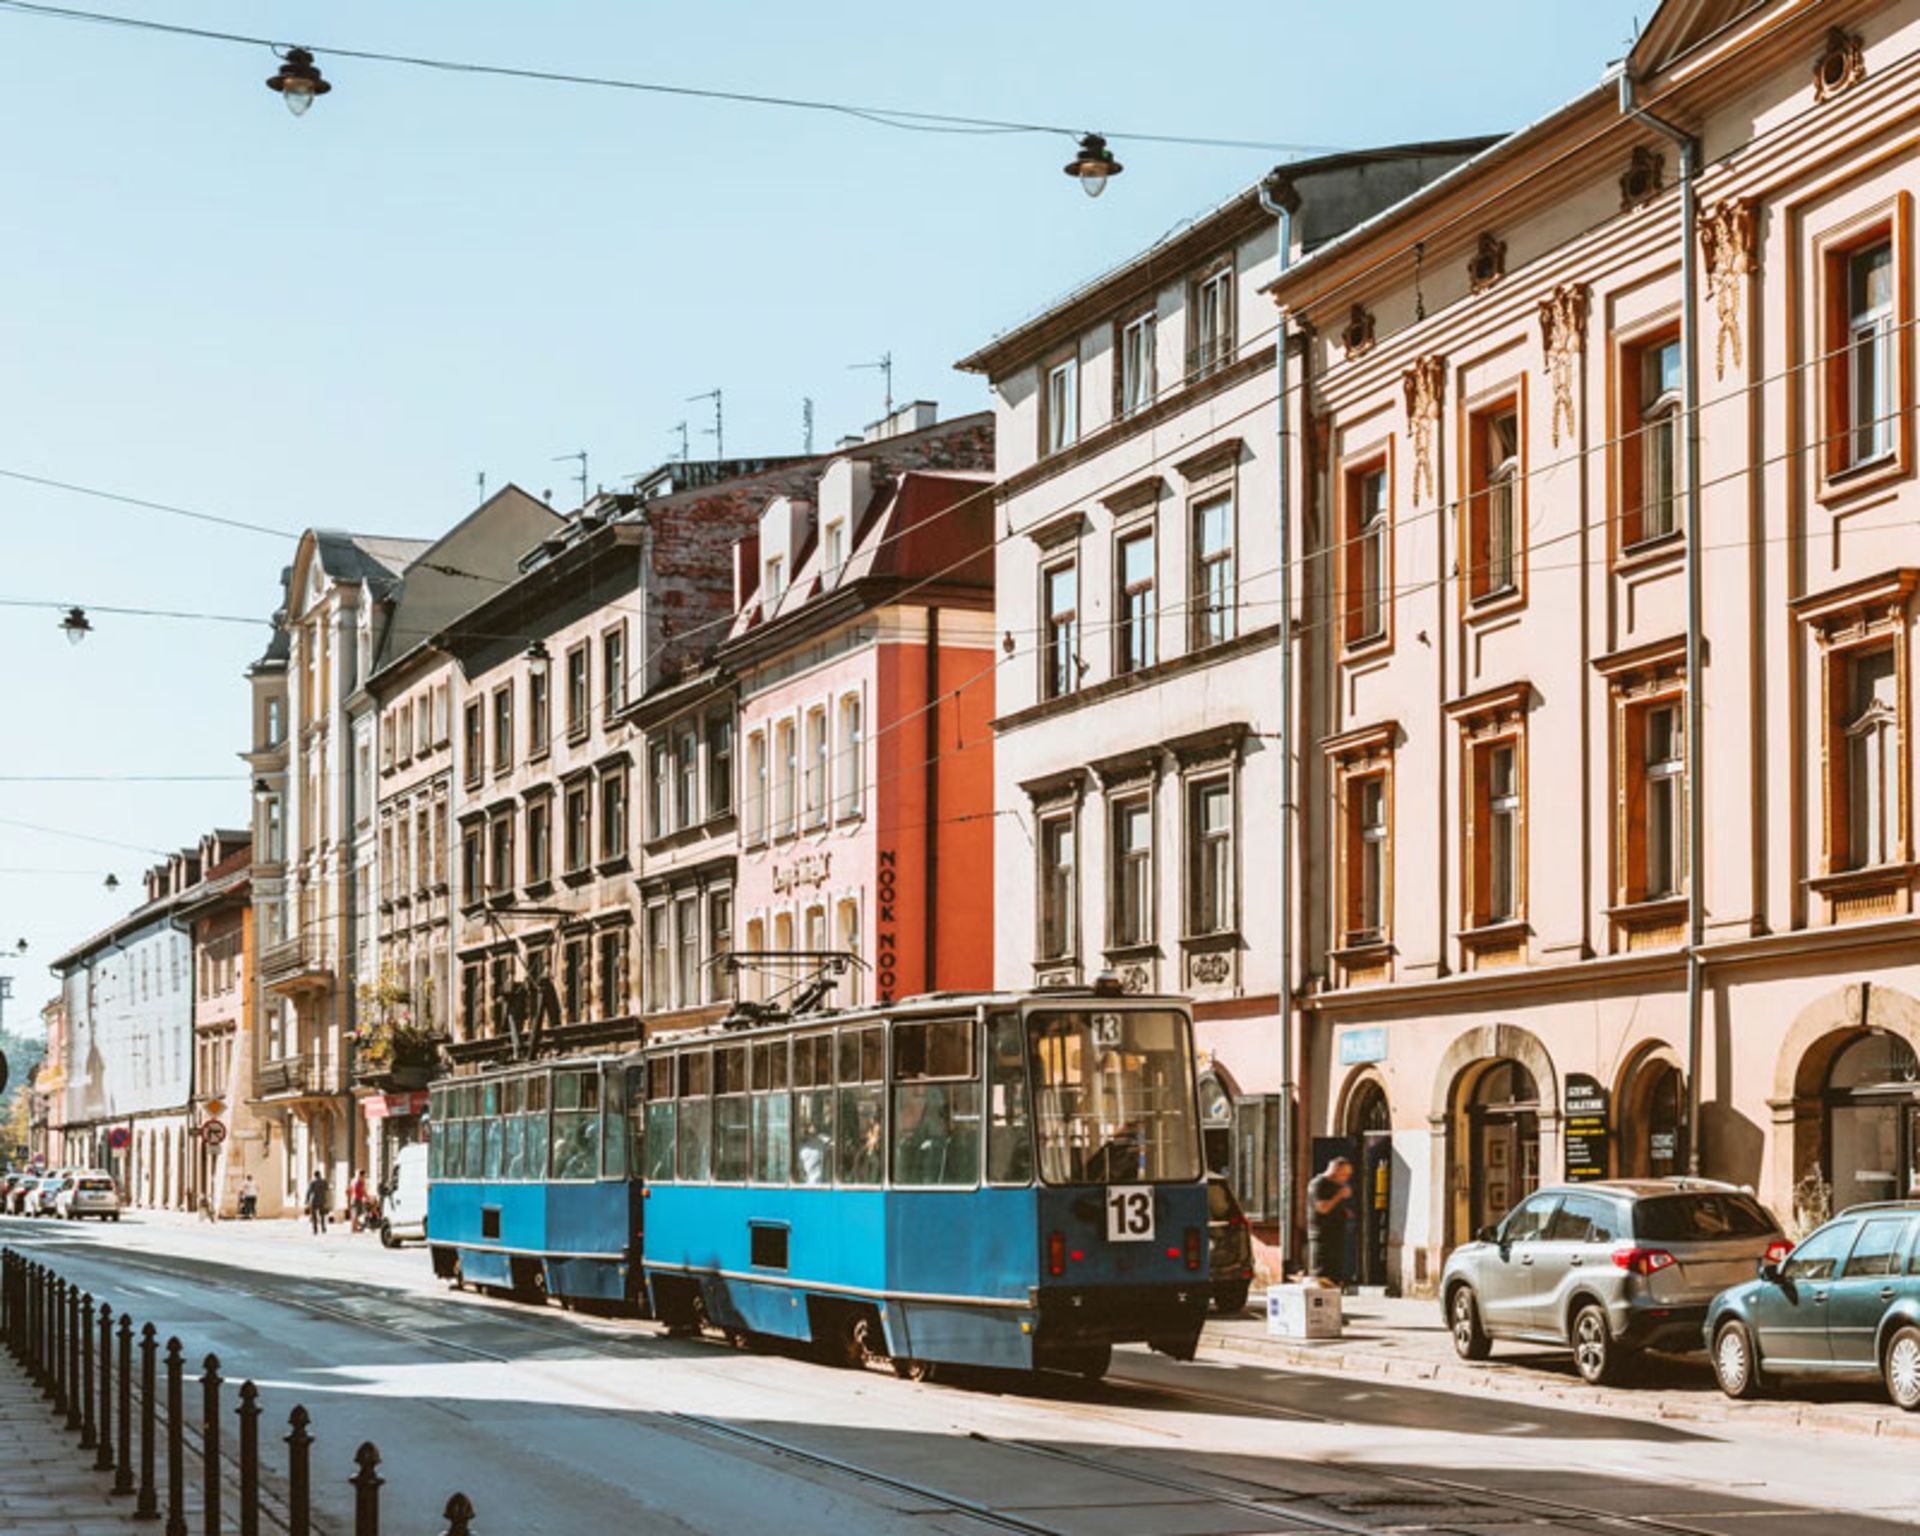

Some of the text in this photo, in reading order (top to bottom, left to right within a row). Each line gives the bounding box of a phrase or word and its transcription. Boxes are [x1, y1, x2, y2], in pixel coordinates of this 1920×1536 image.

[880, 851, 896, 922] NOOK
[1094, 1014, 1118, 1042] 13
[1110, 1193, 1151, 1235] 13
